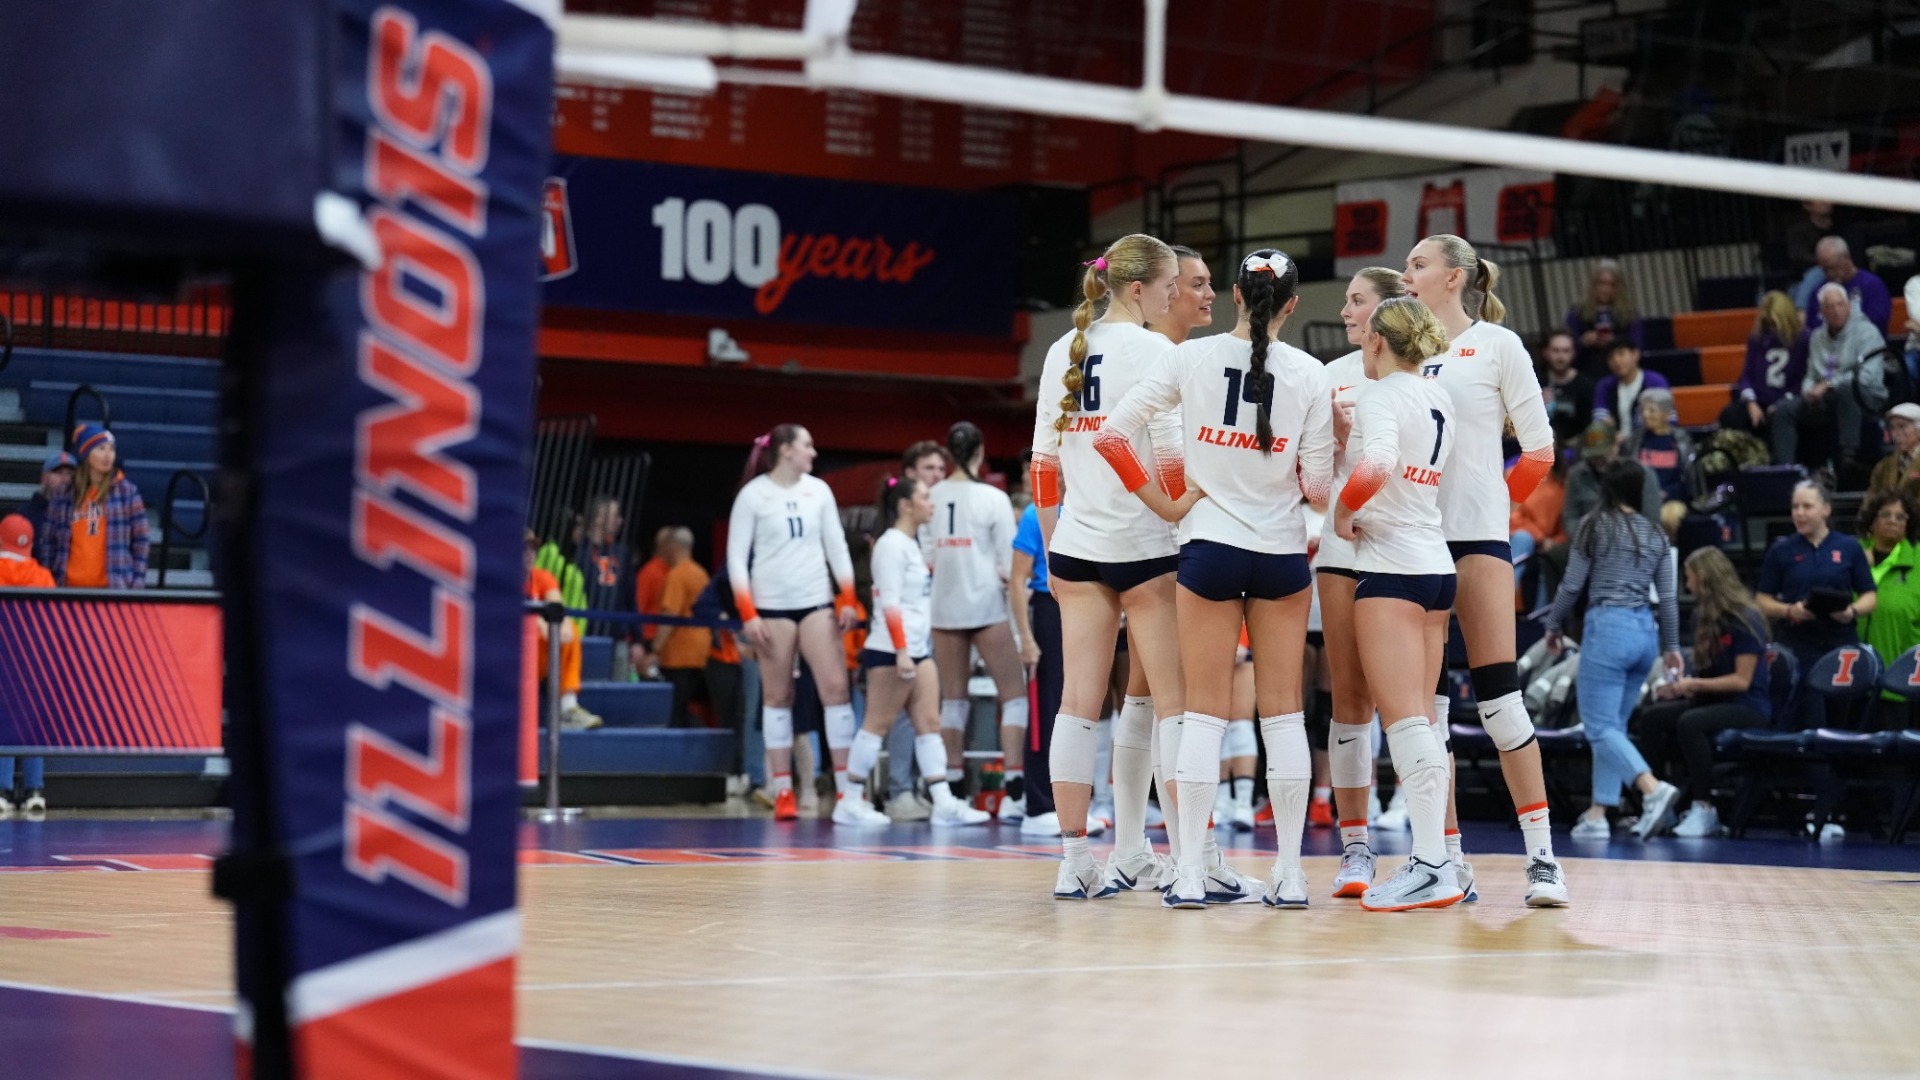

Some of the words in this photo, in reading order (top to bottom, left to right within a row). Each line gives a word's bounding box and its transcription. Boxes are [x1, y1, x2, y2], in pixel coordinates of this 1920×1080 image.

[1789, 142, 1822, 165] 101
[651, 197, 781, 289] 100
[754, 233, 936, 315] years
[343, 5, 493, 907] ILLINOIS
[787, 516, 803, 539] 11
[1832, 649, 1861, 686] I
